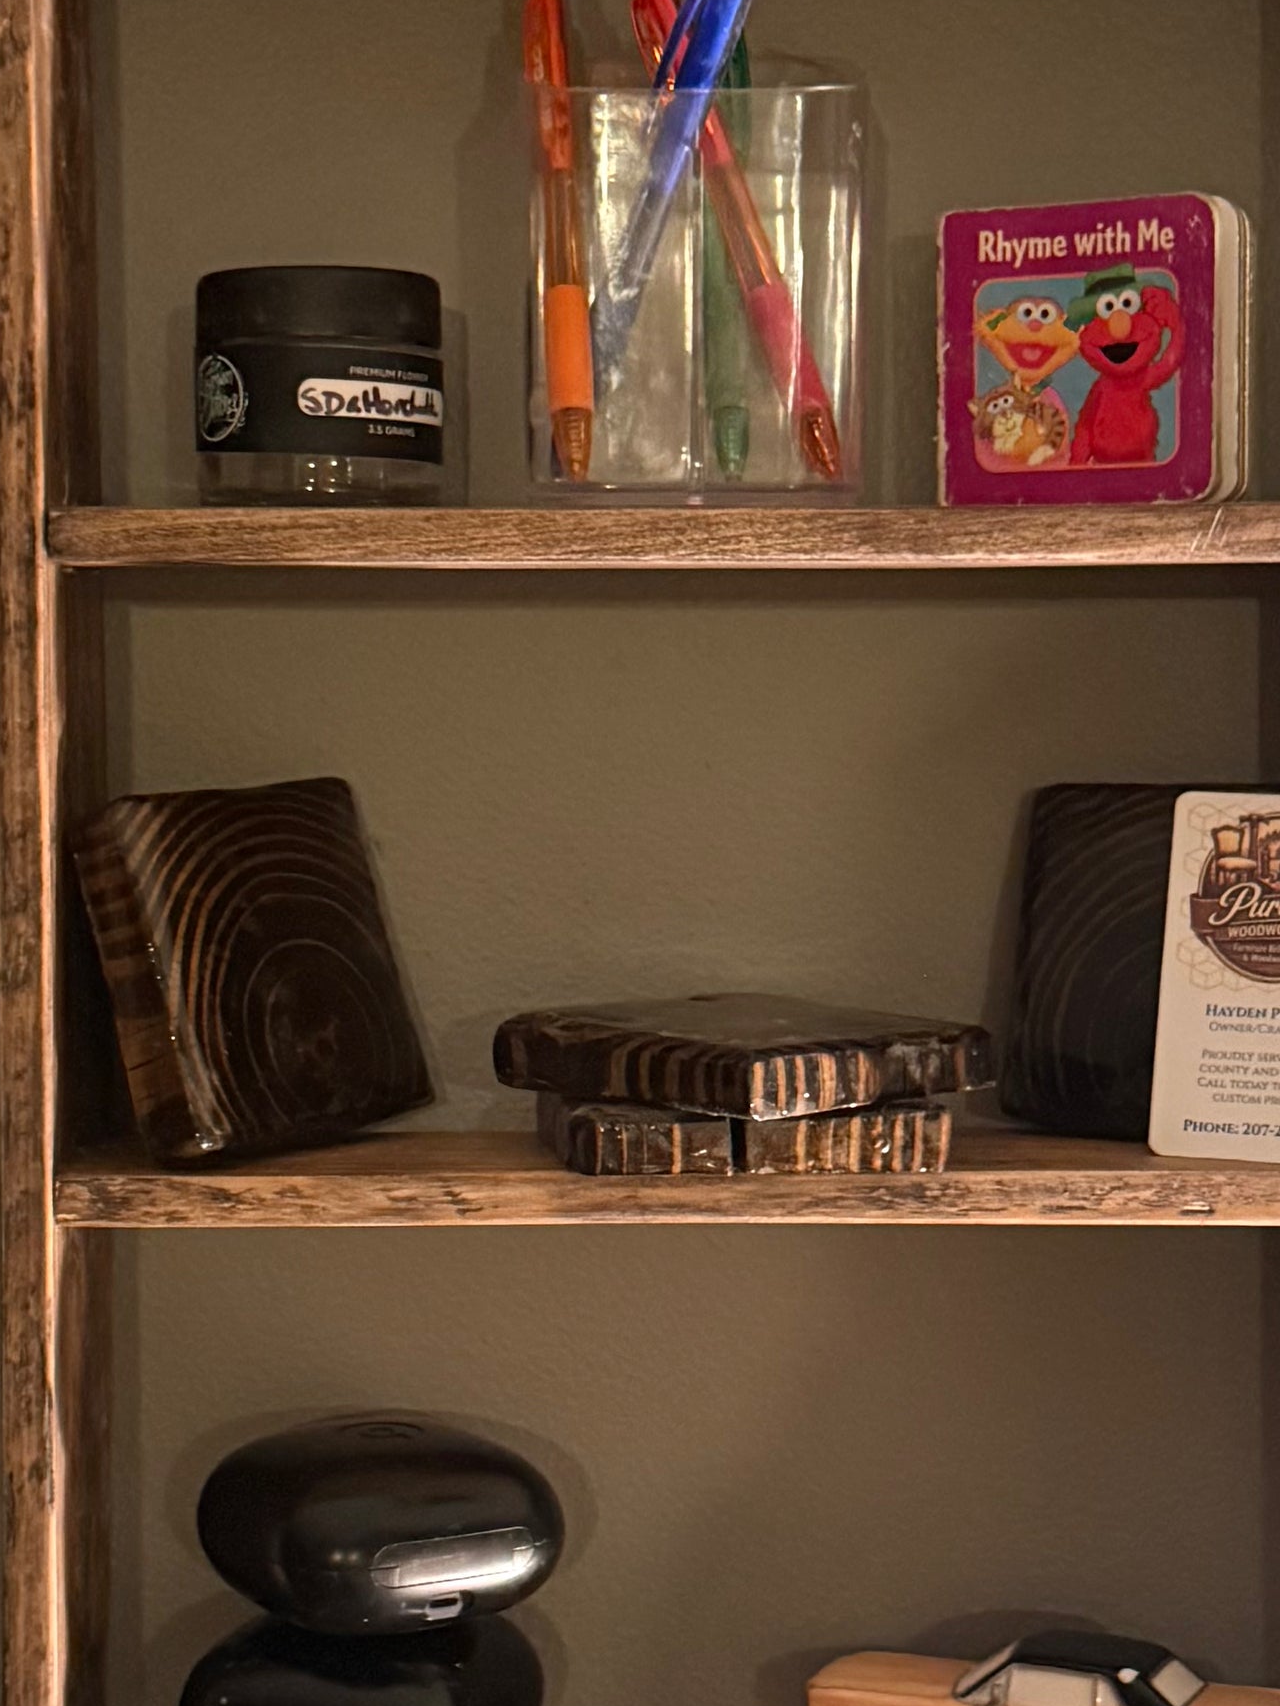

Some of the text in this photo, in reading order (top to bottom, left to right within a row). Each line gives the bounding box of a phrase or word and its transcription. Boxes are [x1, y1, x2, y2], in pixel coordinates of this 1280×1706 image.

[978, 218, 1176, 270] Rhyme with Me
[1205, 1004, 1267, 1019] HAYDEN
[1201, 1048, 1255, 1062] PROUDLY
[1199, 1064, 1250, 1075] COUNTY
[1252, 1066, 1280, 1077] AND
[1197, 1076, 1227, 1089] CALL
[1230, 1079, 1269, 1091] TODAY
[1212, 1093, 1262, 1105] CUSTOM
[1183, 1118, 1240, 1135] PHONE:
